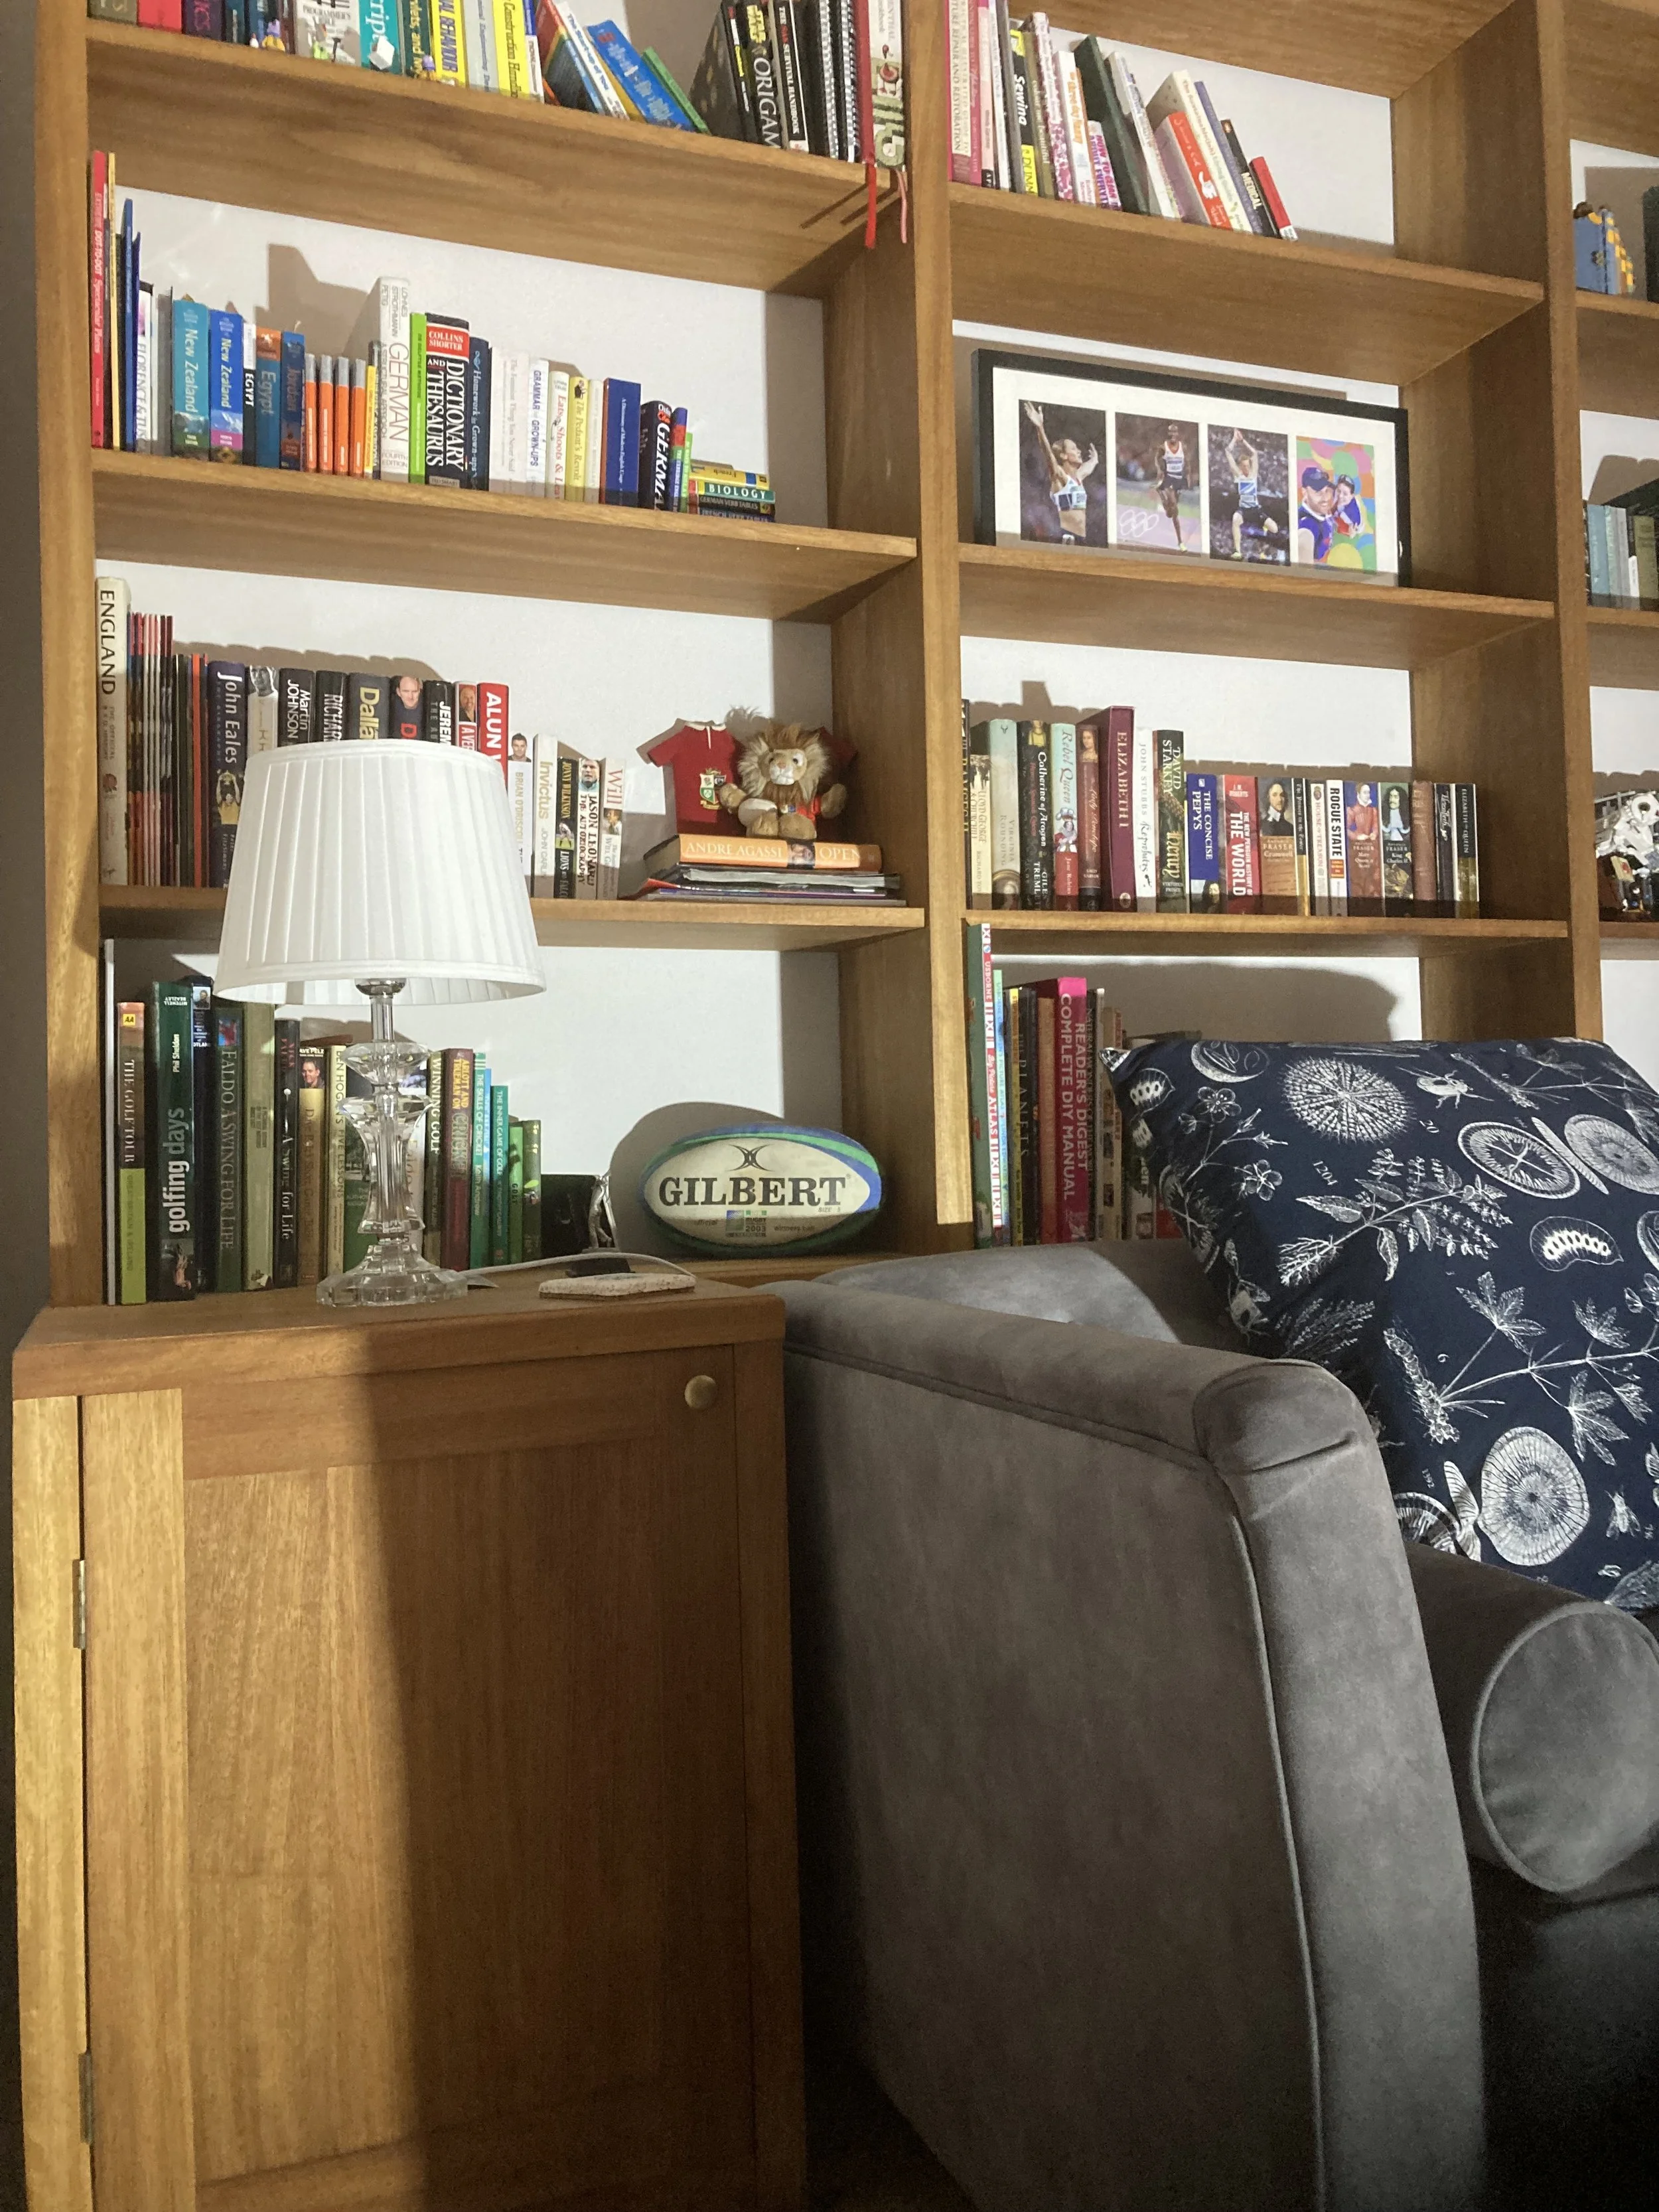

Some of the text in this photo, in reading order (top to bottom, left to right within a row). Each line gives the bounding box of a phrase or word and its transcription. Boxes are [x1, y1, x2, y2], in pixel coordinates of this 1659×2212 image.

[783, 44, 800, 134] SURVIVAL HANDBOOK
[952, 86, 962, 151] RESTORATION
[94, 229, 104, 276] DOT-TO-DOT
[428, 331, 464, 343] COLLINS
[429, 339, 463, 351] SHORTER
[185, 329, 199, 413] New Zealand
[220, 337, 232, 408] New Zealand
[427, 358, 446, 368] AND
[244, 372, 255, 407] EGYPT
[257, 370, 277, 417] Egypt
[389, 342, 409, 441] GERMAN
[425, 370, 445, 467] THESAURUS
[445, 362, 465, 472] DICTIONARY
[470, 370, 482, 472] Homework Grown-ups
[530, 370, 541, 467] GRAMMAR GROWN-UPS
[575, 417, 585, 452] Pedant's
[554, 425, 565, 473] Shoots &
[573, 453, 583, 481] Revolt
[700, 496, 758, 510] GERMAN TABLES
[708, 483, 766, 500] BIOLOGY
[100, 589, 116, 695] ENGLAND
[217, 671, 243, 764] John Eales
[287, 679, 299, 739] JOHNSON
[298, 689, 311, 730] Martin
[486, 691, 502, 749] ALUN
[1037, 751, 1047, 800] Catherine
[1060, 729, 1074, 804] Rebel Queen
[1117, 731, 1129, 818] ELIZABETH
[1139, 742, 1147, 773] JOHN
[1163, 739, 1173, 795] STARKEY
[1172, 745, 1181, 790] DAVID
[515, 771, 524, 797] BRIAN
[538, 761, 553, 820] Invictus
[561, 762, 572, 820] JONNY WILKINSON
[606, 769, 623, 805] Will
[1139, 776, 1148, 816] STUBBS
[1330, 787, 1342, 824] ROGUE
[978, 816, 987, 843] GEORGE
[1038, 811, 1048, 848] Aragon
[1192, 790, 1202, 830] PEPYS
[559, 849, 569, 871] LIONS
[578, 814, 587, 883] AUTOBIOGRAPHY
[587, 795, 597, 886] JASON LEONARD
[736, 844, 782, 858] AGASSI
[819, 848, 861, 861] OPEN
[1204, 815, 1213, 861] CONCISE
[1230, 811, 1247, 896] THE WORLD
[1331, 825, 1342, 857] STATE
[983, 962, 993, 1003] USBORNE
[431, 1057, 442, 1152] WINNING GOLF
[452, 1058, 462, 1110] TRUEMAN ON
[461, 1059, 470, 1108] ARLOTT AND
[1060, 993, 1075, 1201] COMPLETE DIY MANUAL
[1075, 1022, 1088, 1170] READER'S DIGEST
[124, 1059, 135, 1163] THE GOLF TOUR
[476, 1111, 483, 1122] OF
[988, 1097, 998, 1136] ATLAS
[1419, 1120, 1440, 1134] 20
[163, 1107, 190, 1233] golfing days
[220, 1050, 237, 1250] FALDO A SWING FOR LIFE
[496, 1148, 503, 1157] OF
[1313, 1161, 1338, 1186] 1204
[336, 1153, 345, 1199] LESSONS
[658, 1176, 846, 1207] GILBERT
[281, 1191, 293, 1211] for
[281, 1214, 294, 1240] Life
